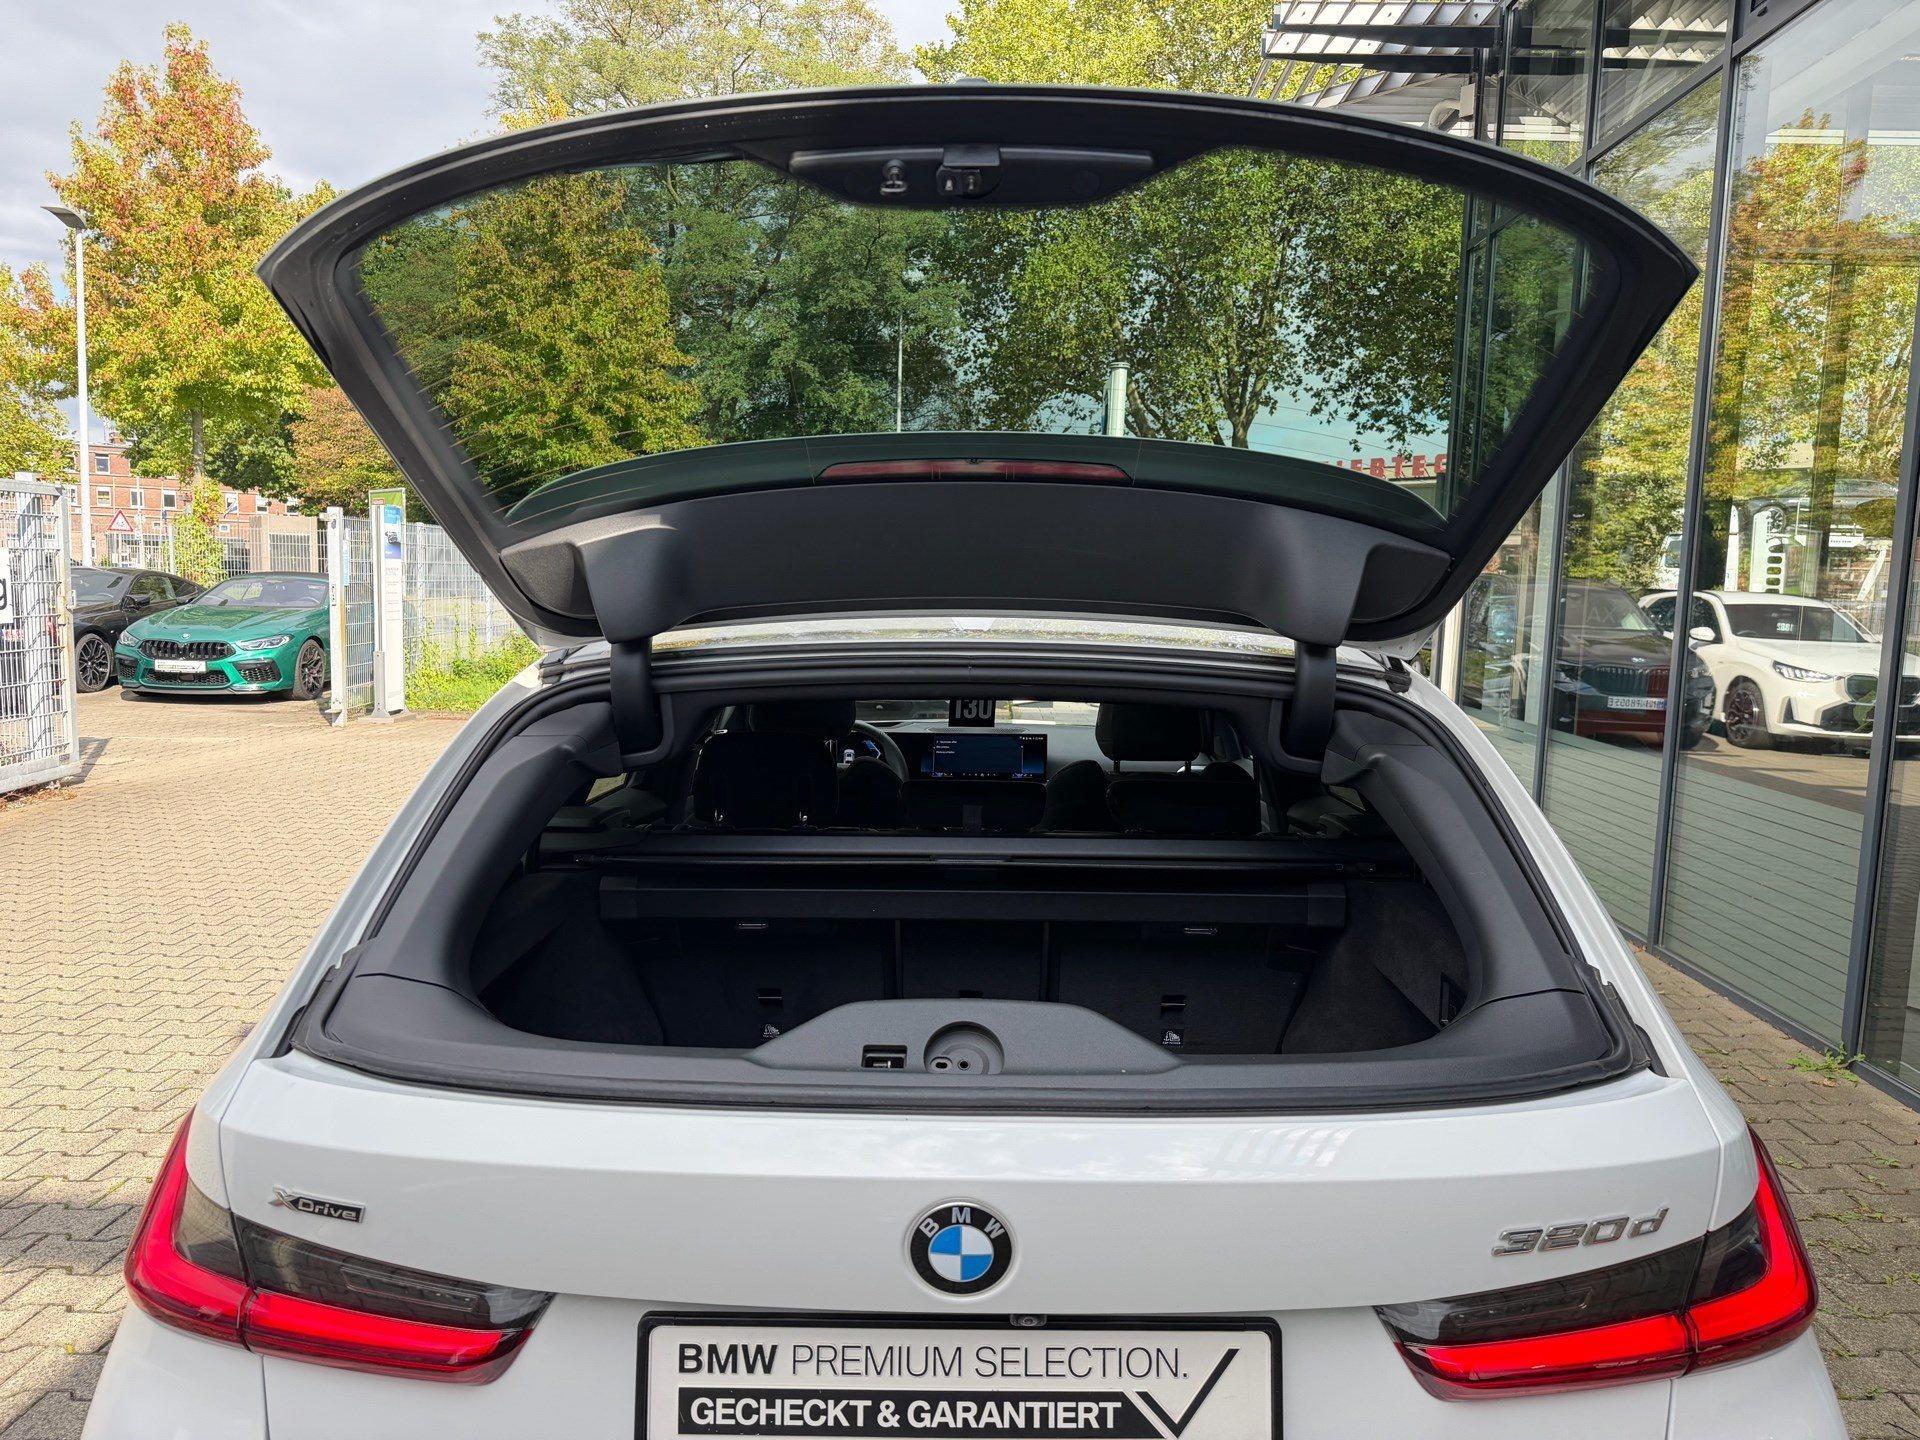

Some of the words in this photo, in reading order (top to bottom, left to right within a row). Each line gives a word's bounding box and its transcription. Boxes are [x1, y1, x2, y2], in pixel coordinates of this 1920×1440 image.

[919, 1206, 1005, 1239] BMW
[1491, 1205, 1670, 1257] 320d
[678, 1343, 778, 1374] BMW
[792, 1344, 962, 1377] PREMIUM
[974, 1346, 1188, 1378] SELECTION.
[690, 1397, 872, 1427] GECHECKT
[876, 1400, 900, 1428] &
[907, 1400, 1122, 1429] GARANTIERT
